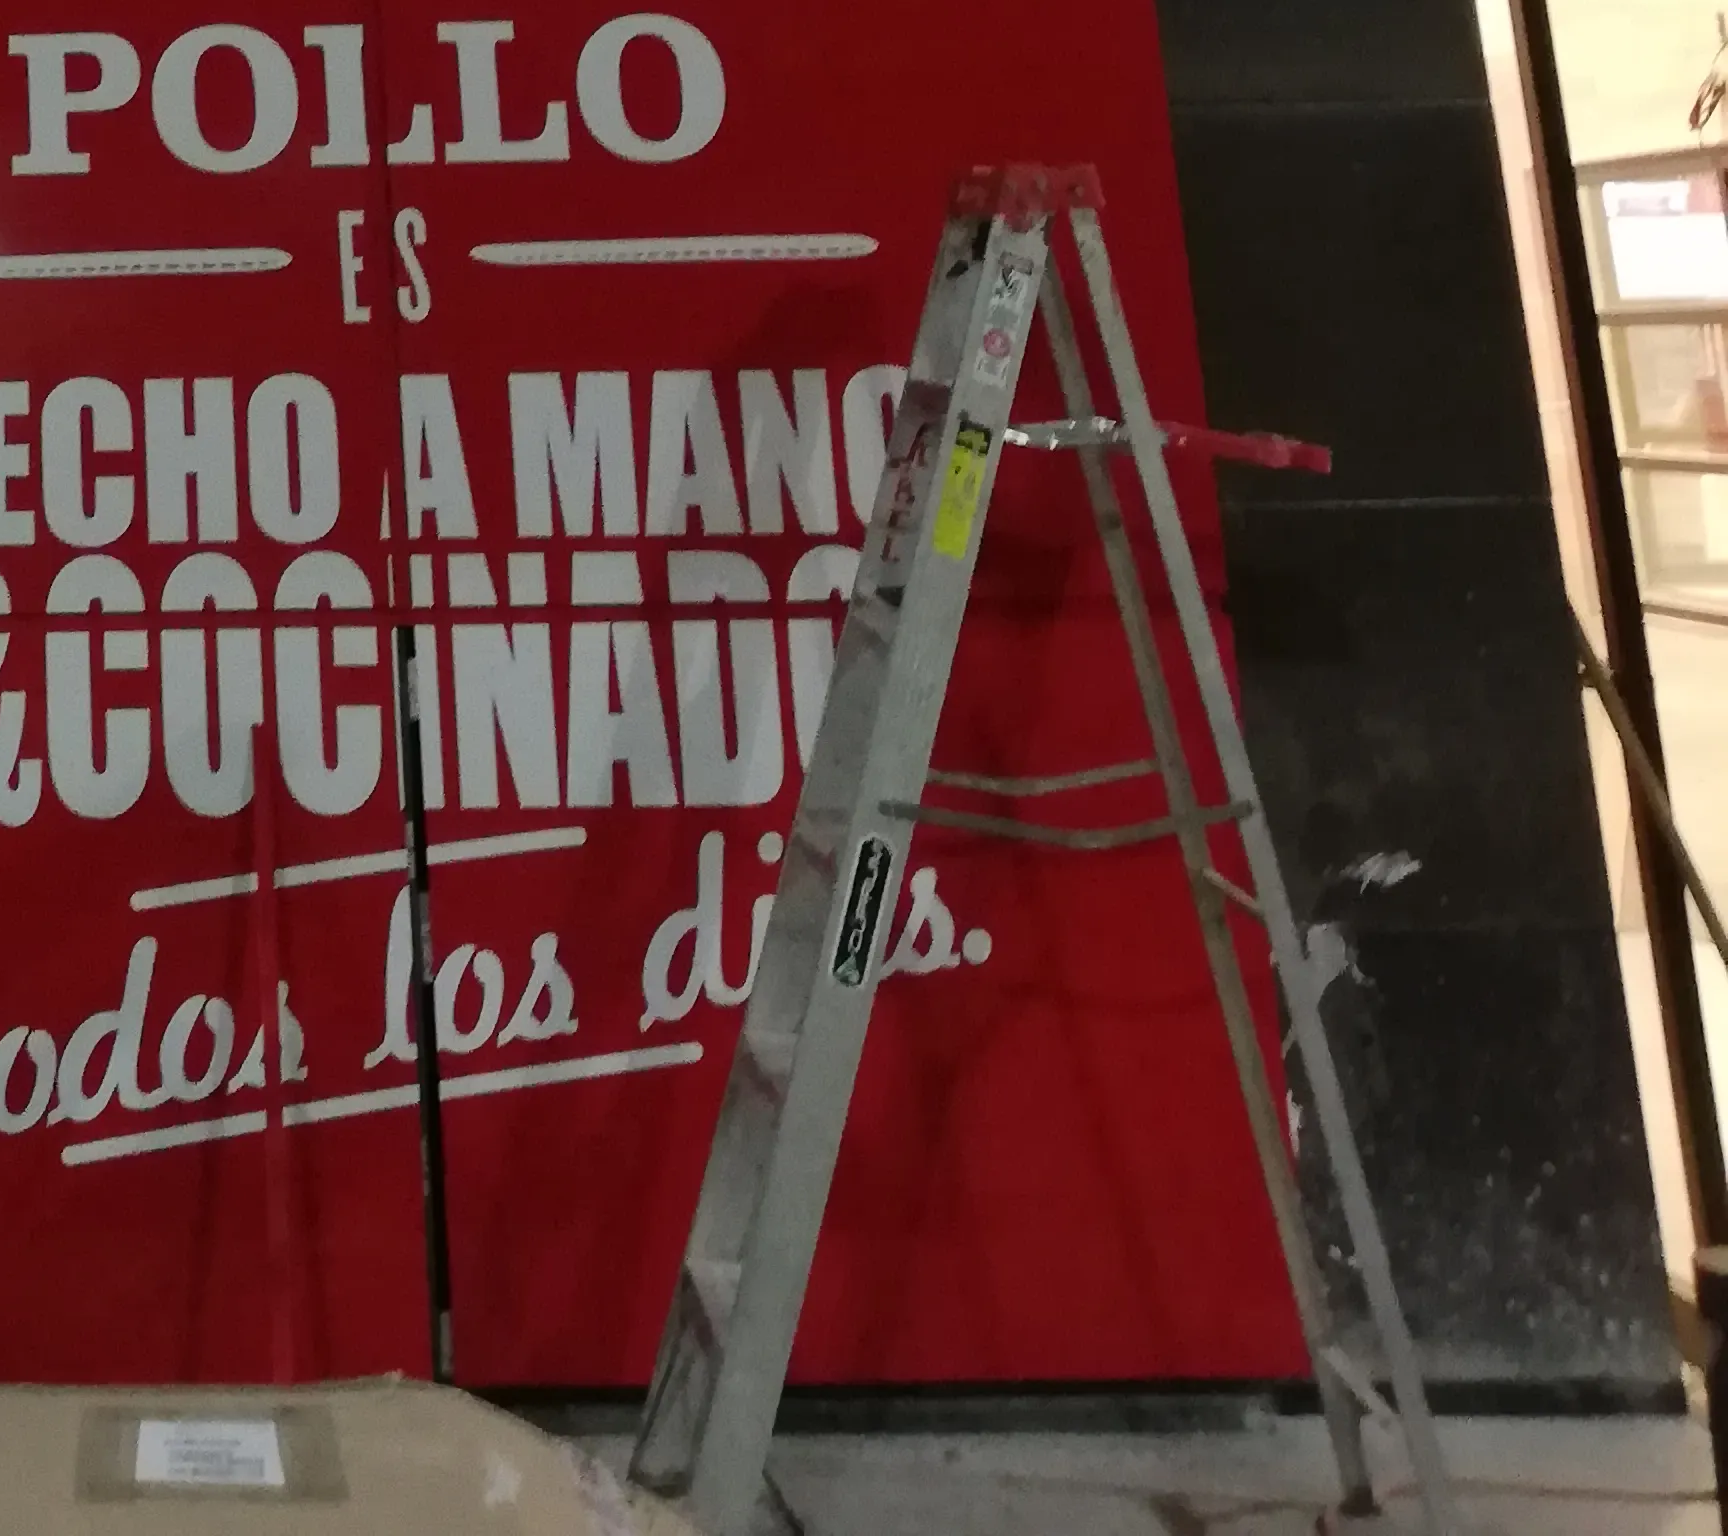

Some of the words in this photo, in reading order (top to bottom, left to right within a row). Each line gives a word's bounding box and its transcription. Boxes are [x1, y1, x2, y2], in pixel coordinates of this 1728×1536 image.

[8, 13, 727, 176] POLLO
[338, 207, 432, 325] ES
[379, 372, 480, 540] A
[363, 884, 579, 1071] los
[638, 830, 993, 1033] dis.
